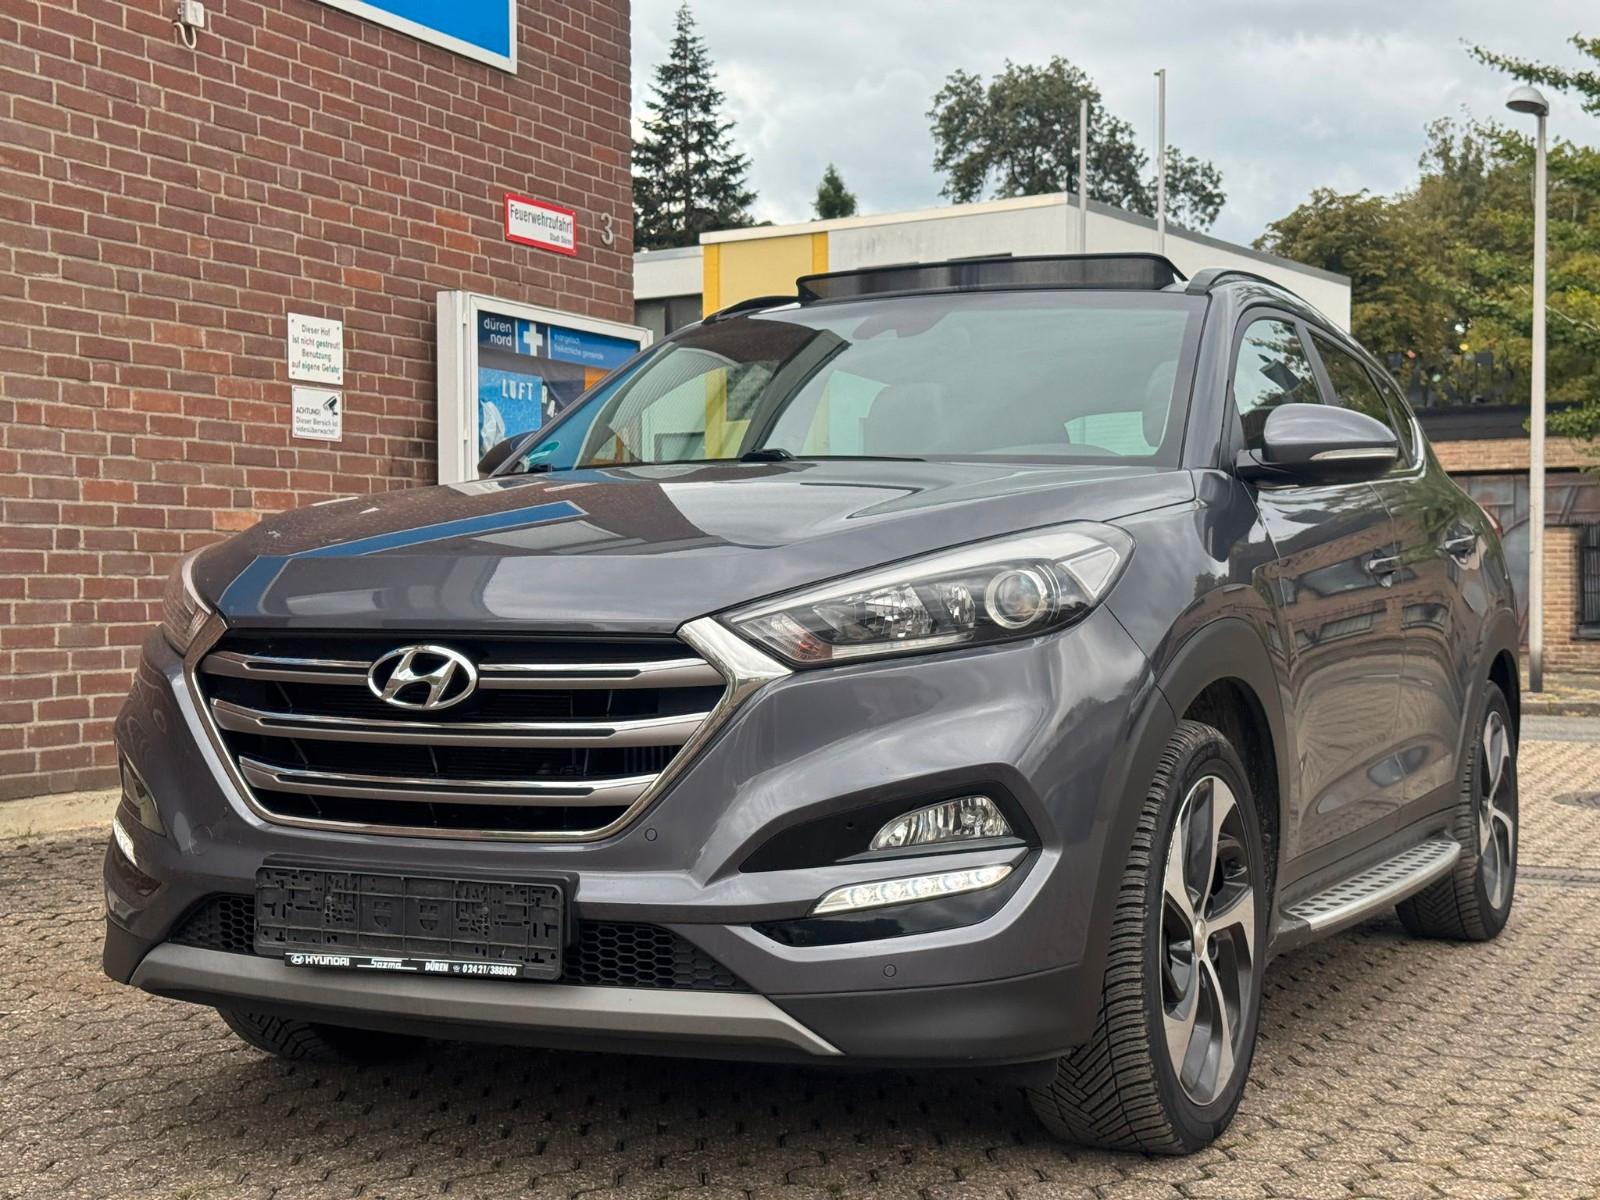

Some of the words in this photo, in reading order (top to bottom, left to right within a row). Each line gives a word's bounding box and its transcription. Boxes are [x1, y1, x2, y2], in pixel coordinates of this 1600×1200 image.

[510, 203, 572, 234] Feuerwehrzufahrt
[600, 212, 614, 245] 3
[302, 324, 320, 334] Dieser
[320, 326, 330, 336] Hof
[484, 318, 512, 332] düren
[300, 336, 315, 346] nicht
[490, 333, 512, 346] nord
[302, 348, 332, 362] Benutzung
[291, 360, 300, 368] auf
[302, 362, 320, 372] eigene
[502, 378, 534, 401] LUFT
[296, 416, 312, 425] Dieser
[305, 955, 350, 966] HYUNDAI
[424, 960, 449, 972] DÜREN
